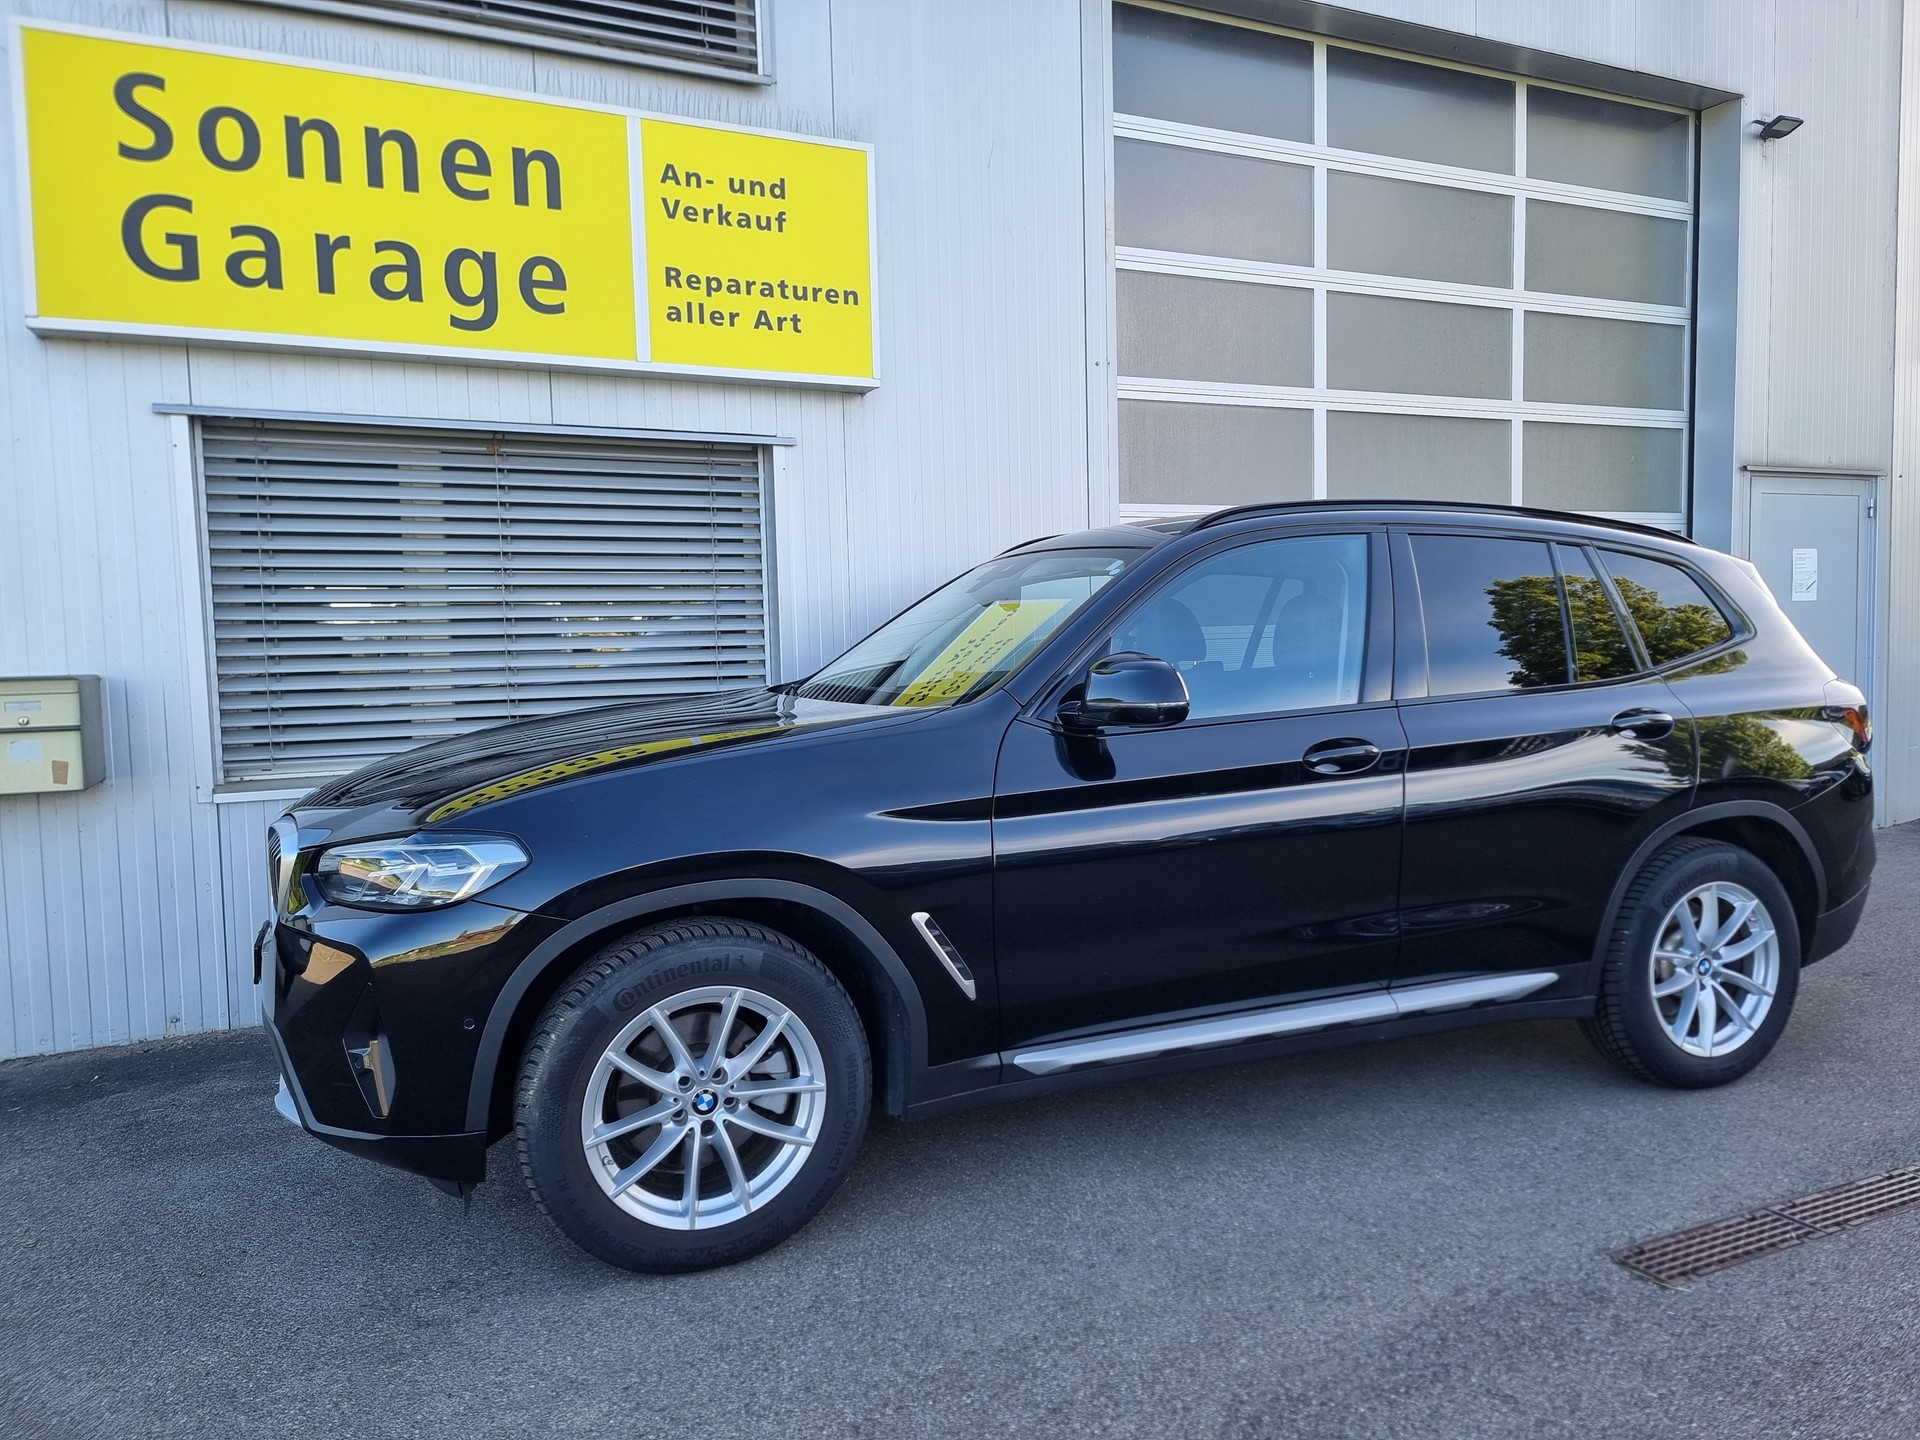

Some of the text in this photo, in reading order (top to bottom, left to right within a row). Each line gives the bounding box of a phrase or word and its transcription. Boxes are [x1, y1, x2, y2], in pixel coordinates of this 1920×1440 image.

[113, 72, 562, 211] Sonnen
[660, 163, 786, 200] An- und
[660, 197, 787, 233] Verkauf
[121, 193, 568, 332] Garage
[664, 266, 859, 306] Reparaturen
[666, 301, 802, 334] aller Art
[612, 953, 730, 1012] Continental
[826, 1052, 858, 1174] WinterContact
